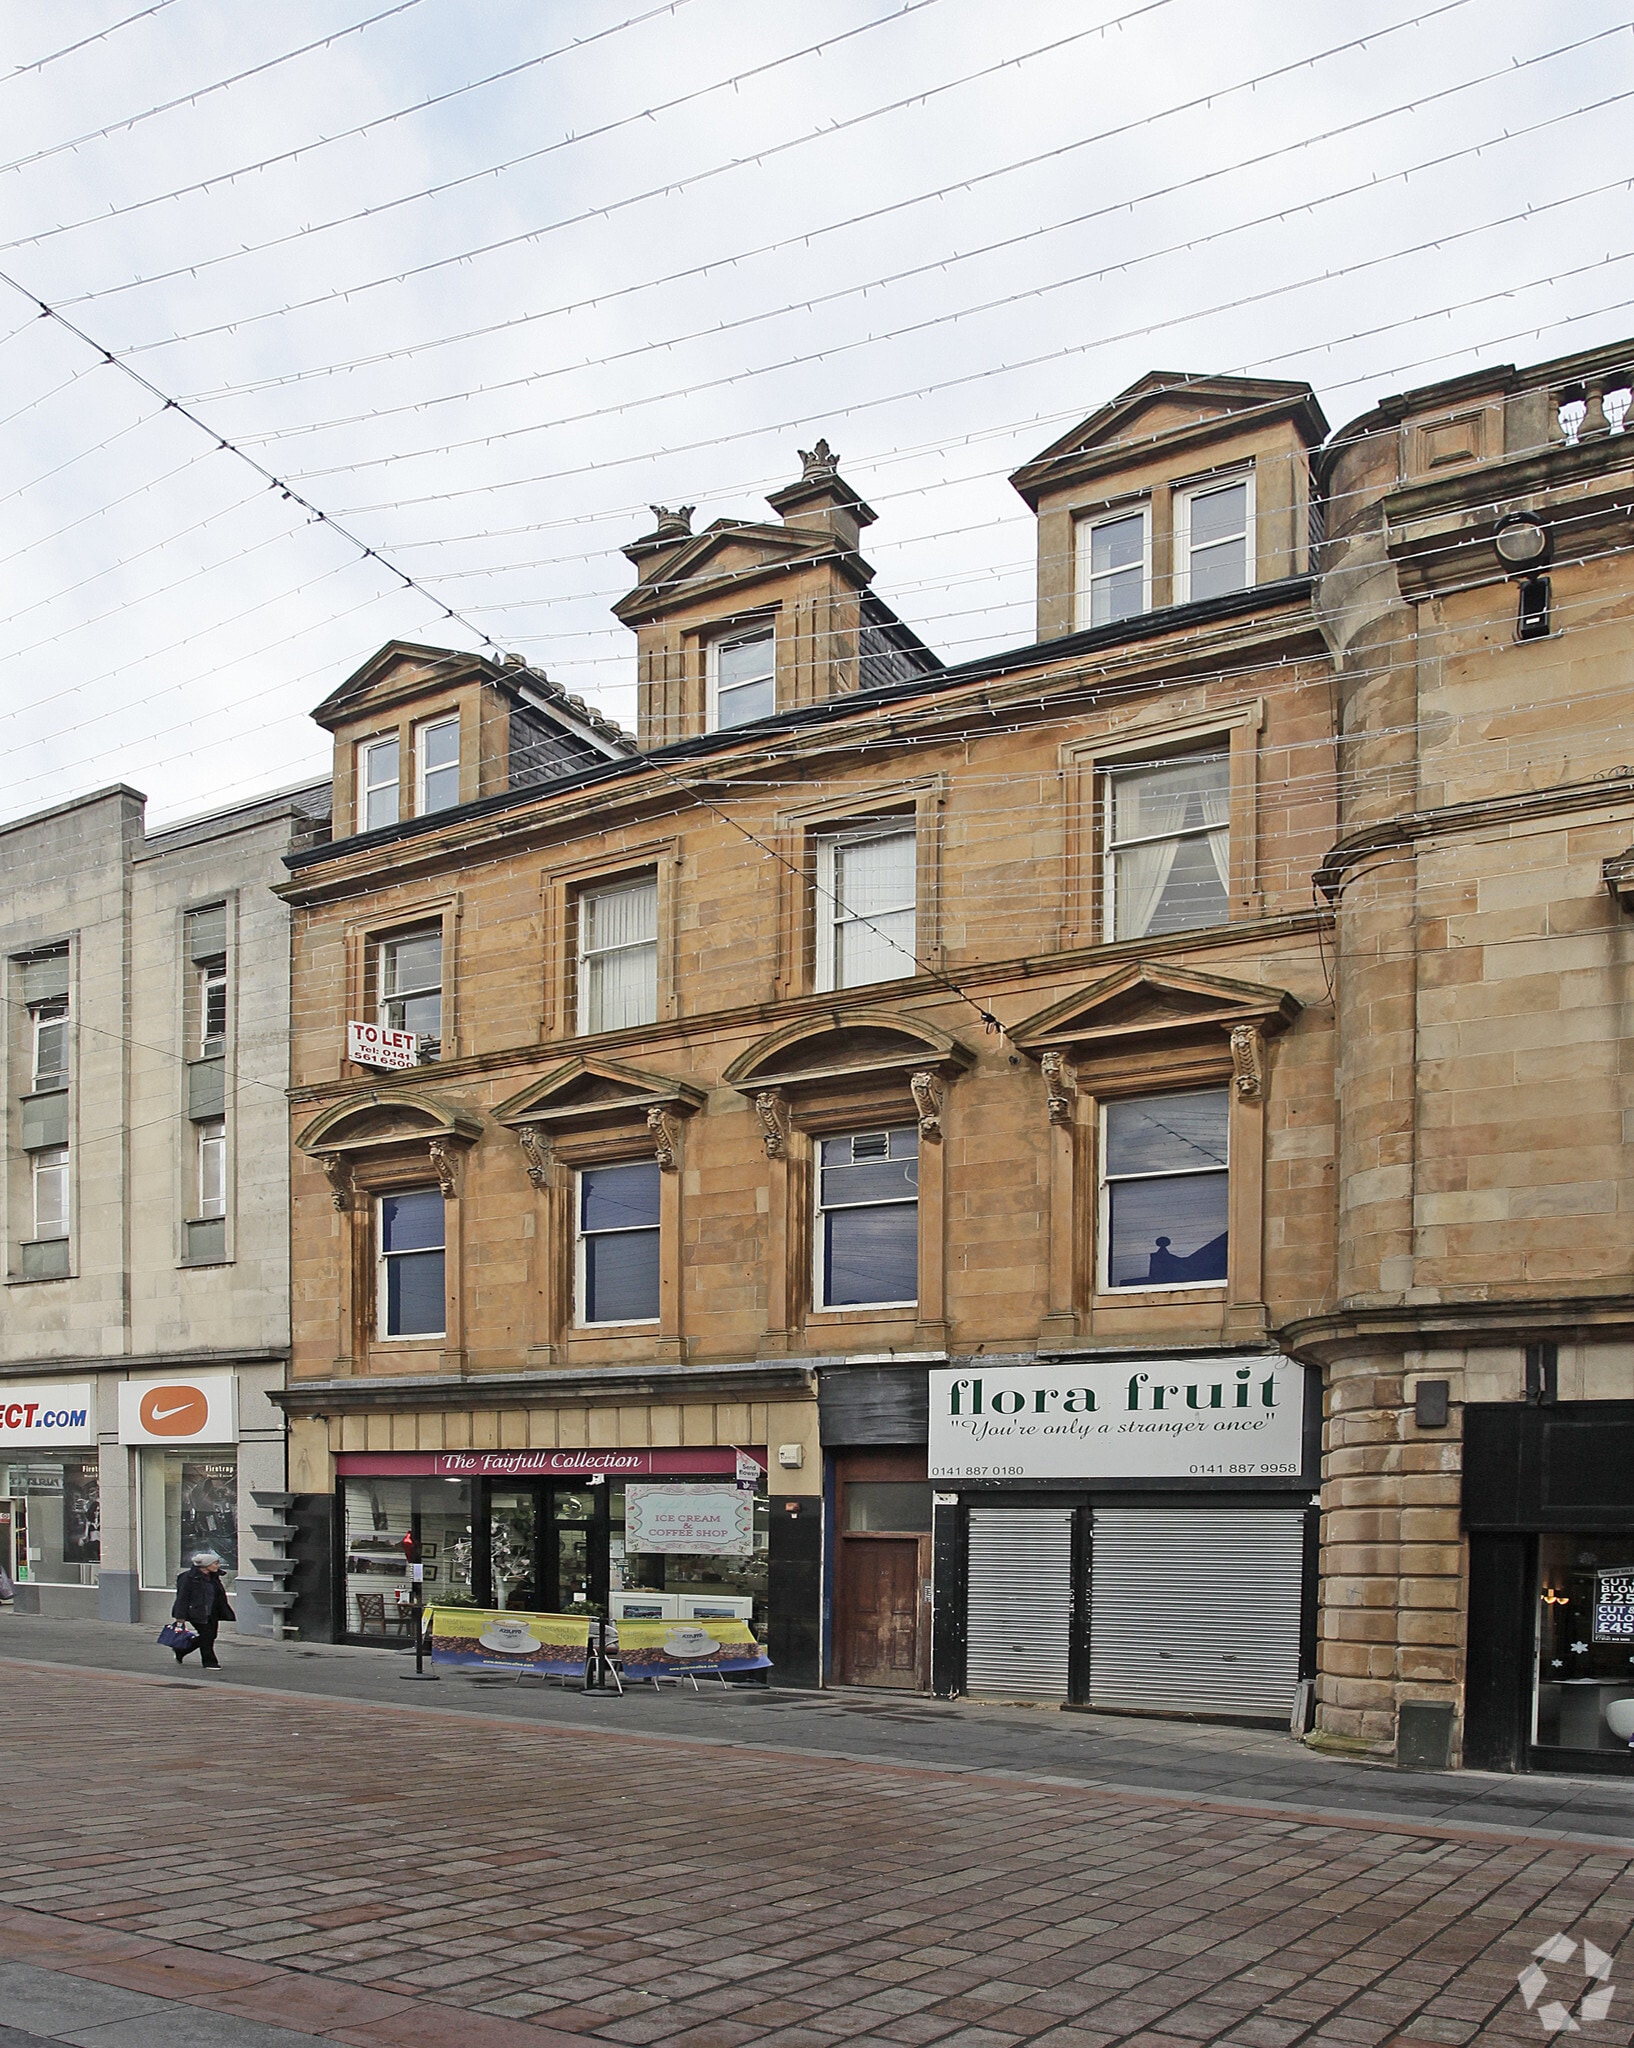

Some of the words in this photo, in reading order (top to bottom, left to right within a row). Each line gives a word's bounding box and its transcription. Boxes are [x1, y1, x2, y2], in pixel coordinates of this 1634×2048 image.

[354, 1025, 378, 1042] TO
[382, 1030, 414, 1049] LET
[359, 1045, 379, 1054] Tel:
[383, 1050, 410, 1060] 0141
[354, 1052, 377, 1062] 561
[380, 1057, 414, 1068] 6500
[947, 1378, 1100, 1415] flora
[1124, 1367, 1281, 1411] fruit
[951, 1419, 1039, 1441] "You're
[1043, 1418, 1094, 1439] only
[1097, 1424, 1113, 1433] a
[1117, 1420, 1210, 1437] stranger
[1213, 1412, 1276, 1431] once"
[442, 1453, 477, 1469] The
[480, 1452, 548, 1473] Fairfull
[551, 1451, 643, 1468] Collection
[205, 1465, 234, 1474] Firetrap
[932, 1467, 961, 1476] 0141
[965, 1466, 989, 1475] 887
[992, 1466, 1024, 1475] 0180
[1189, 1464, 1223, 1473] 0141
[1229, 1464, 1255, 1473] 887
[1260, 1463, 1297, 1473] 9958
[655, 1514, 676, 1522] ICE
[677, 1514, 721, 1523] CREAM
[683, 1522, 693, 1530] &
[648, 1529, 694, 1537] COFFEE
[695, 1529, 729, 1537] SHOP
[1601, 1577, 1629, 1586] CUT
[1600, 1593, 1634, 1604] £25
[1598, 1606, 1626, 1614] CUT
[1598, 1614, 1634, 1622] COLO
[1598, 1622, 1634, 1633] £45
